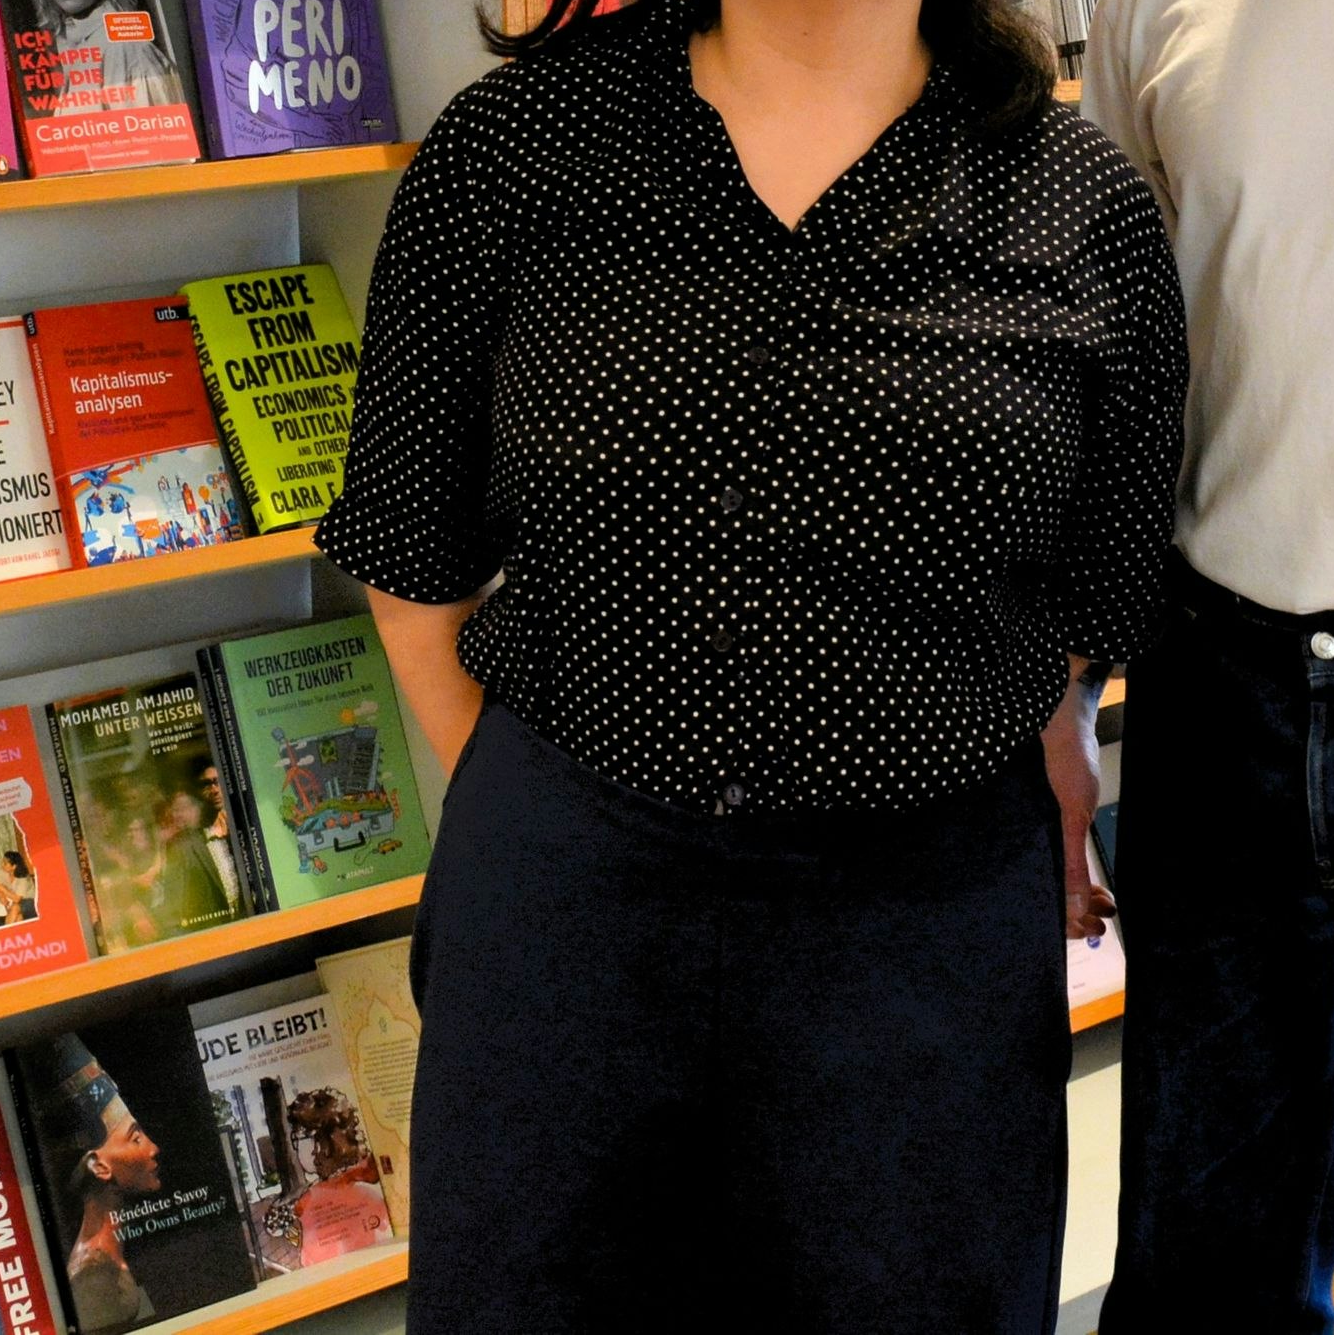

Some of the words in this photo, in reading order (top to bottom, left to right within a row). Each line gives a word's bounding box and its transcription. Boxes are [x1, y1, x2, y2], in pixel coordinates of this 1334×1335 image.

[248, 55, 362, 115] MENO
[36, 119, 120, 143] Caroline
[125, 112, 186, 132] Darian
[156, 306, 180, 321] utb.
[224, 274, 315, 316] ESCAPE
[249, 307, 316, 351] FROM
[70, 368, 174, 394] Kapitalismus-
[225, 340, 366, 393] CAPITALISM
[74, 392, 143, 416] analysen
[244, 636, 367, 679] WERKZEUGKASTEN
[60, 701, 130, 728] MOHAMED
[135, 687, 195, 713] AMJAHID
[244, 1007, 329, 1052] BLEIBT!
[109, 1192, 172, 1226] Bénédicte
[174, 1184, 210, 1213] Savoy
[112, 1224, 142, 1244] Who
[145, 1212, 180, 1234] Owns
[182, 1196, 227, 1229] Beauty?
